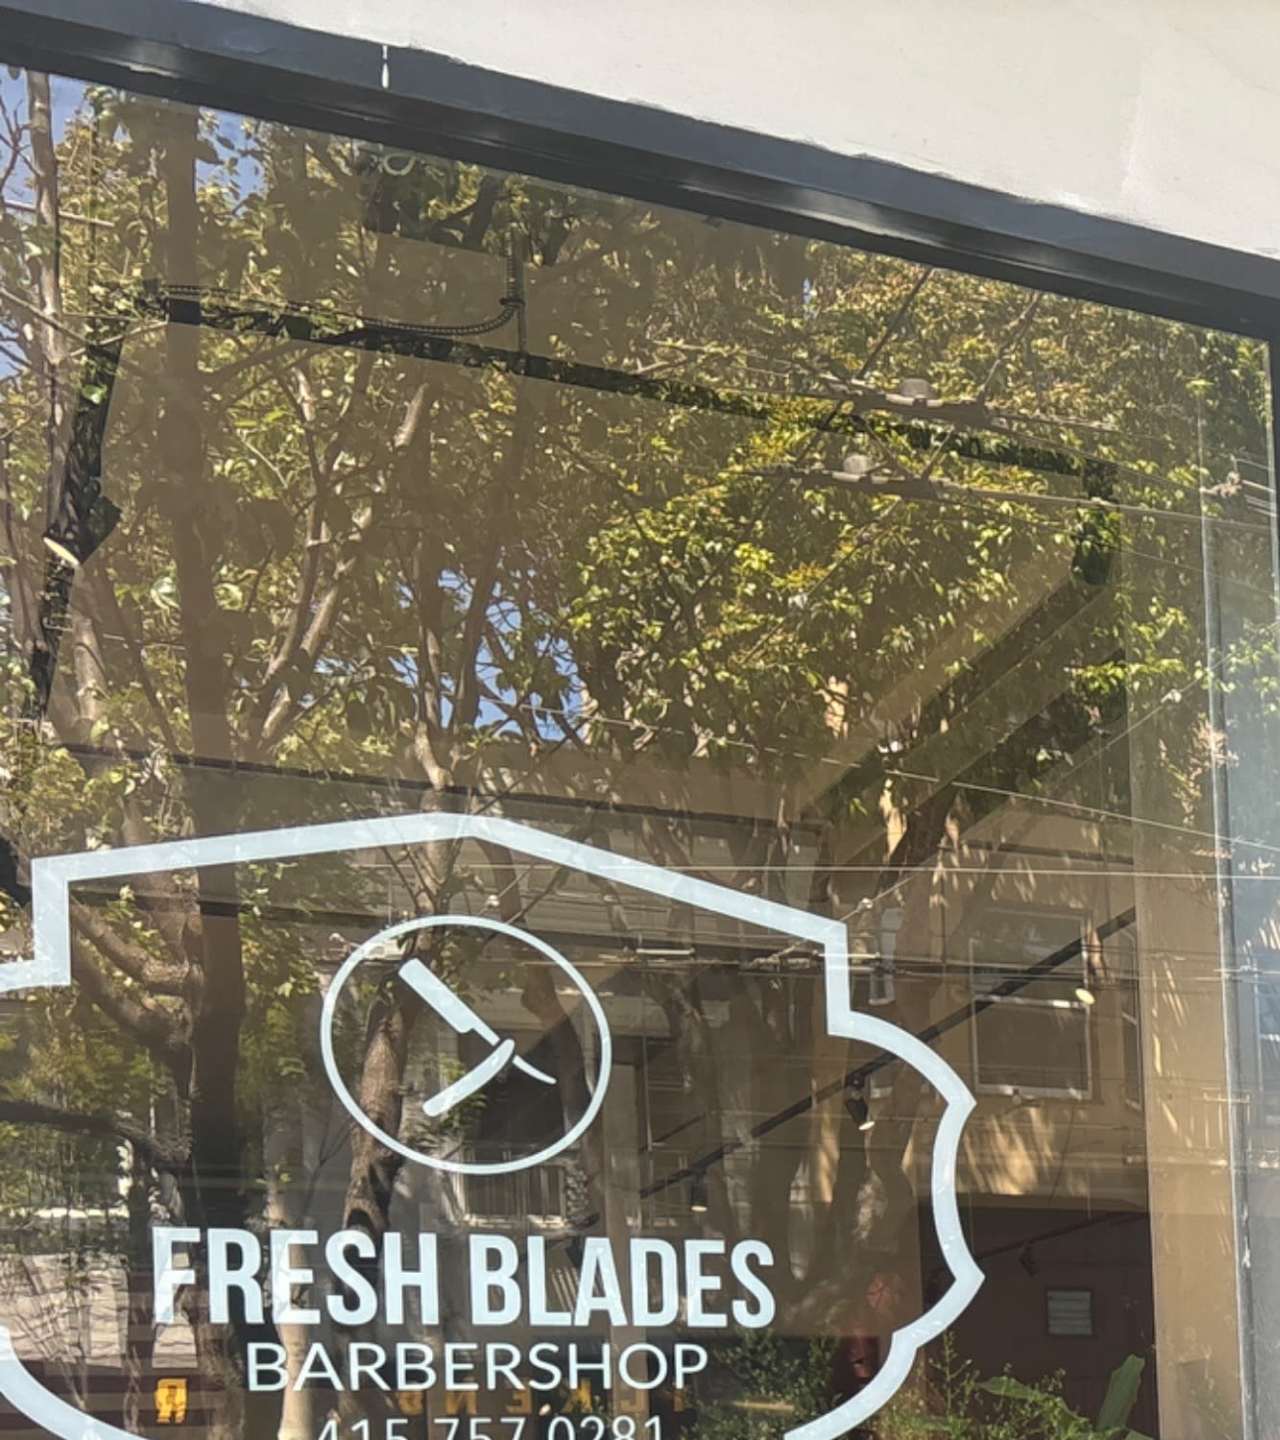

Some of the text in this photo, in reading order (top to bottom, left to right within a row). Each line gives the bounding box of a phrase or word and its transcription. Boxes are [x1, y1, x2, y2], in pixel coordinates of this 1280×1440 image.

[152, 1227, 775, 1328] FRESH BLADES
[246, 1342, 708, 1391] BARBERSHOP
